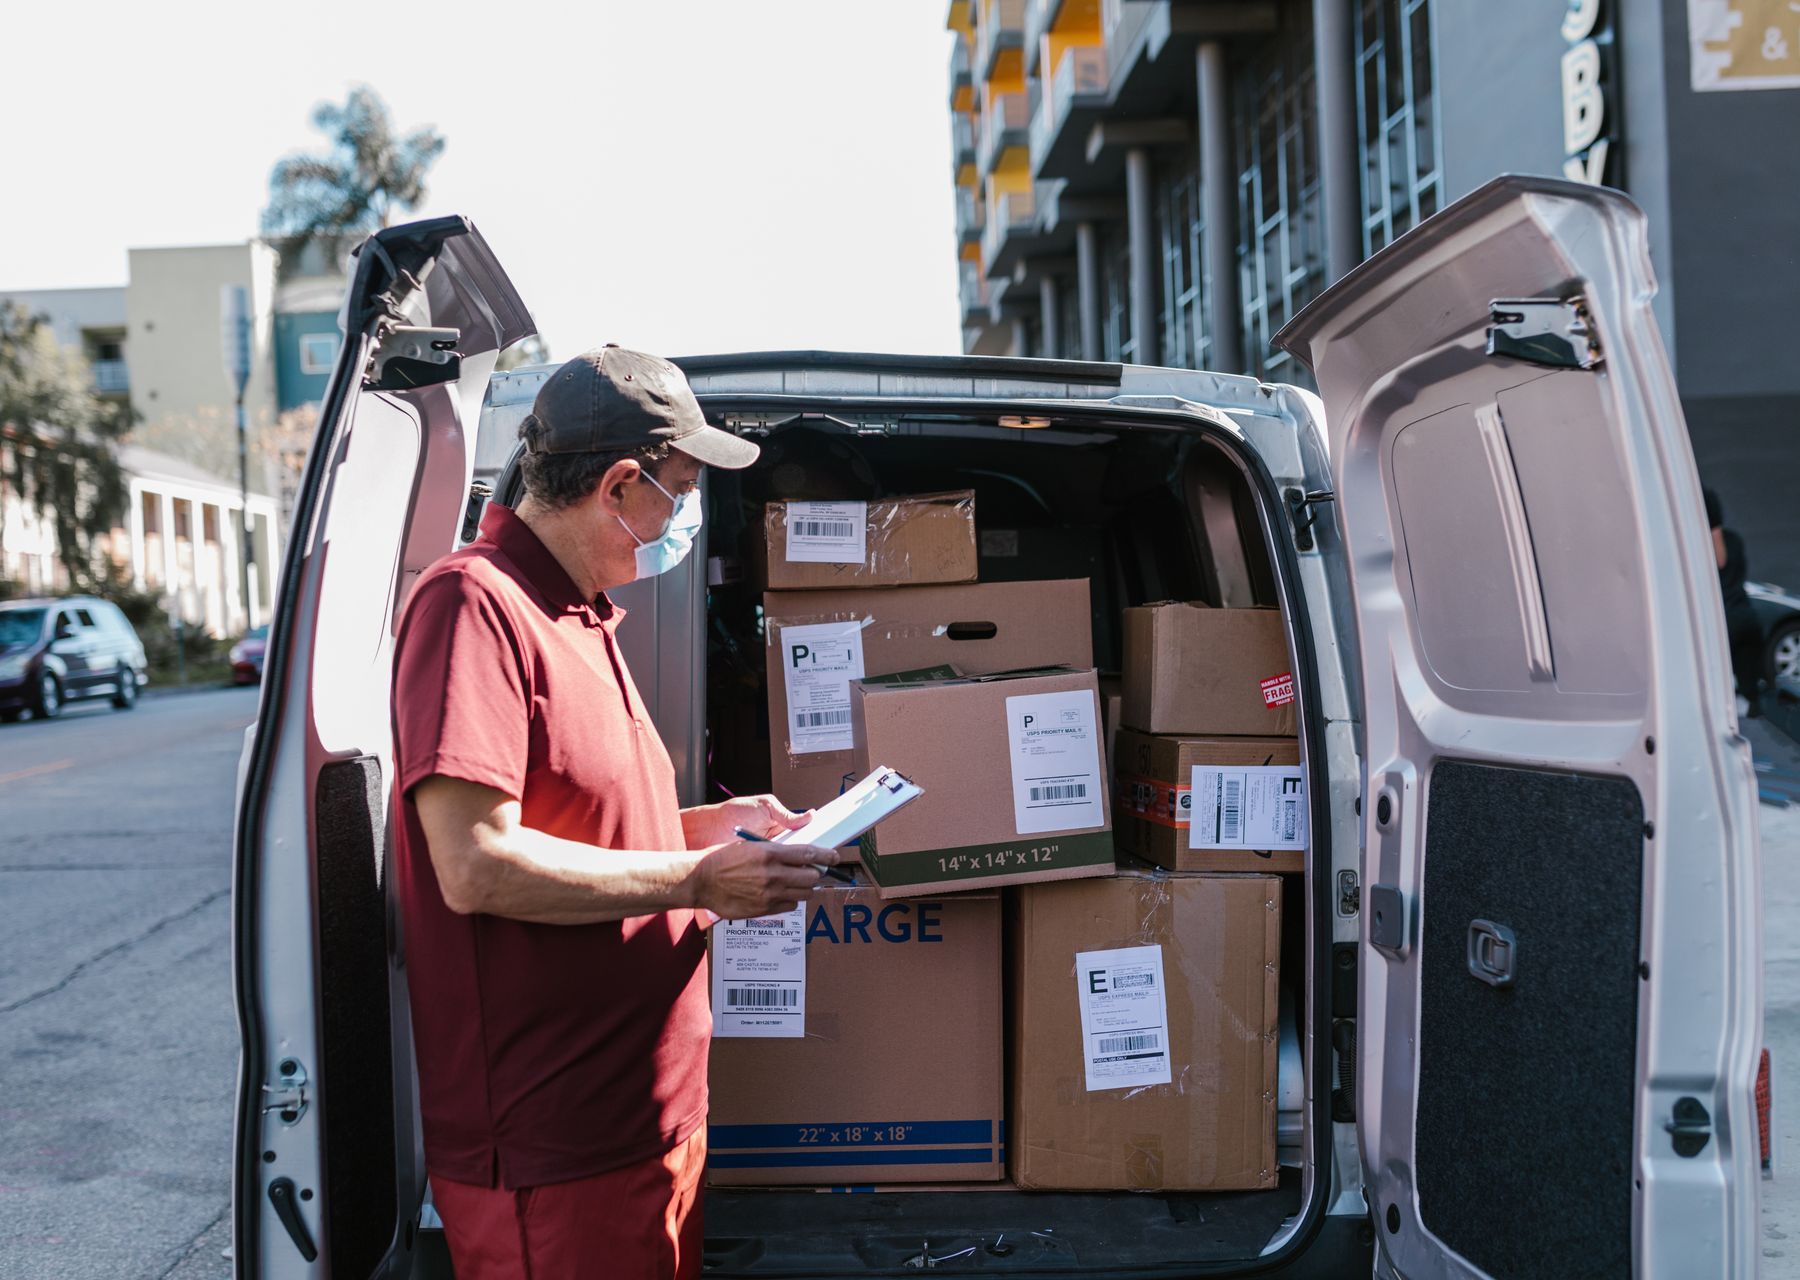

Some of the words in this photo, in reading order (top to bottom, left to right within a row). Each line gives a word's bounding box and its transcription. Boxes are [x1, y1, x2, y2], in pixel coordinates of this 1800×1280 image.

[1761, 26, 1788, 61] &
[791, 644, 810, 668] P
[1024, 715, 1034, 728] P
[938, 855, 967, 872] 14"
[969, 857, 981, 869] x
[984, 850, 1013, 867] 14"
[1016, 852, 1027, 864] x
[1031, 845, 1059, 862] 12"
[805, 903, 943, 944] ARGE
[1089, 969, 1108, 994] E
[798, 1127, 826, 1143] 22"
[830, 1132, 840, 1142] x
[844, 1127, 869, 1142] 18"
[874, 1131, 883, 1141] x
[888, 1126, 913, 1141] 18"
